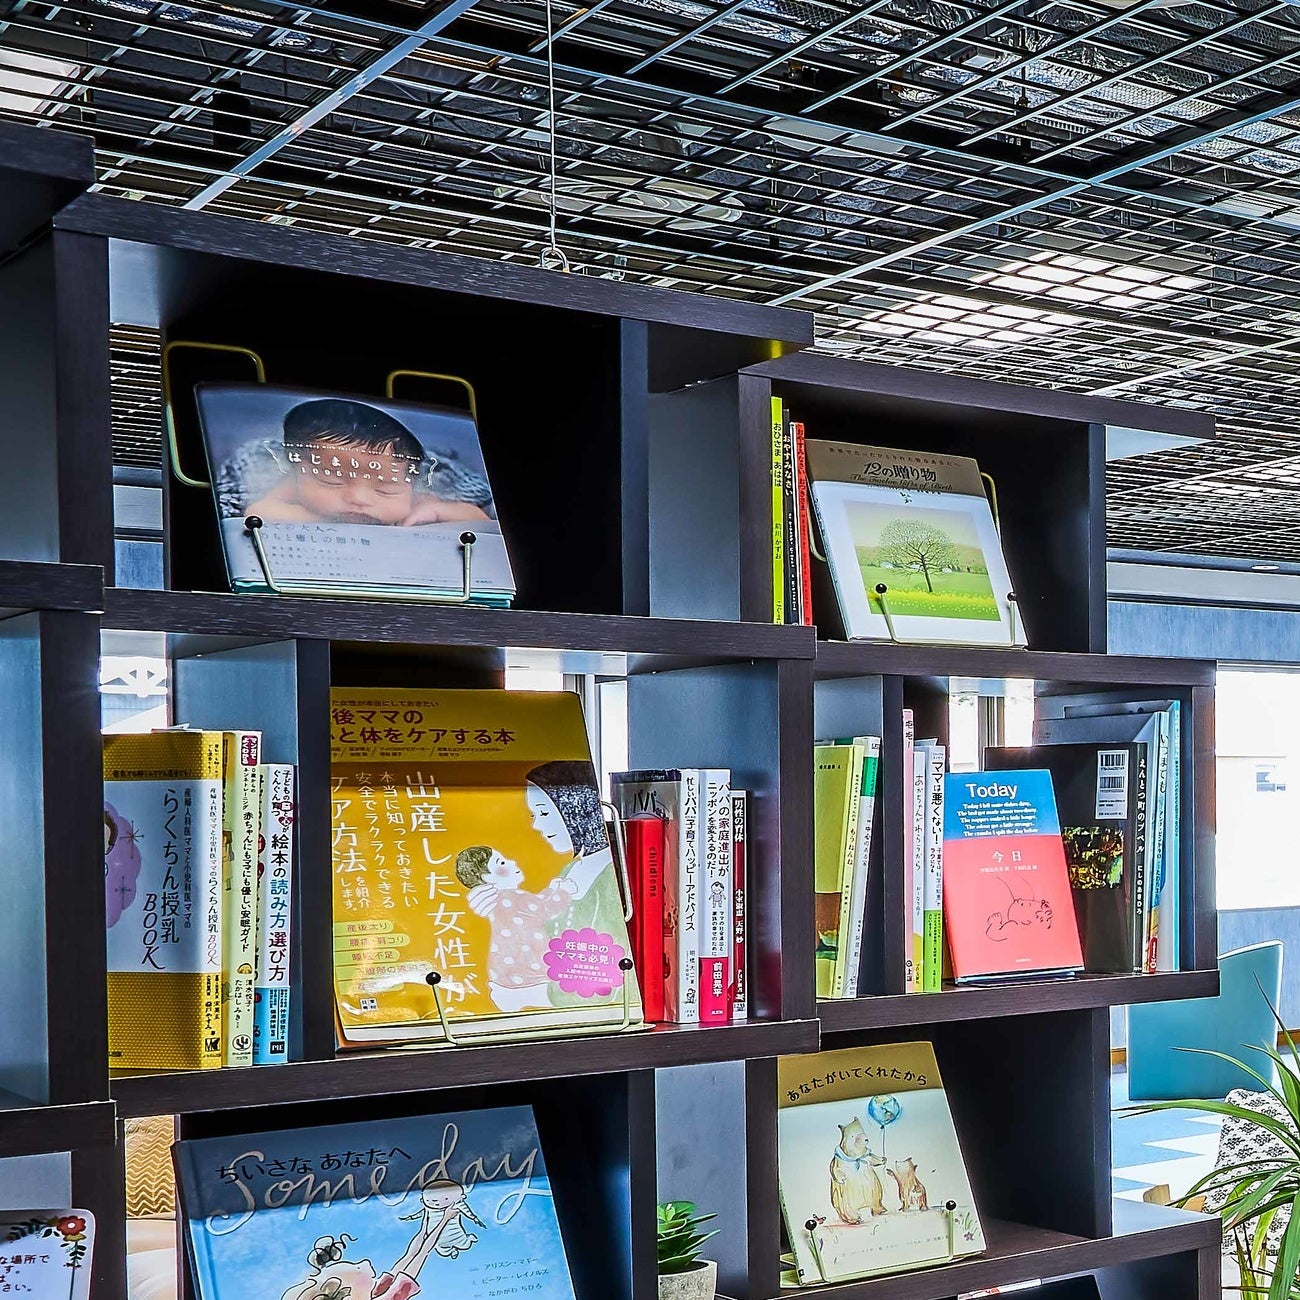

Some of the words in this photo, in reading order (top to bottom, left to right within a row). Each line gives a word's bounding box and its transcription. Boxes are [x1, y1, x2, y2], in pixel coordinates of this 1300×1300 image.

[773, 422, 782, 457] おひさま
[288, 451, 420, 475] はじまりのこえ
[773, 461, 782, 487] あはは
[783, 434, 793, 497] おやすみなさい
[863, 461, 937, 482] 12の贈り物
[930, 761, 943, 845] ママは悪くない!
[964, 782, 1018, 800] Today
[1136, 758, 1147, 854] えんとつ町のプペル
[355, 772, 395, 909] 安全でラクラクできる
[380, 771, 419, 908] 本当に知っておきたい
[717, 782, 730, 877] パパの家庭進出が
[734, 799, 744, 843] 男性の育休
[161, 788, 182, 944] らくちん授乳
[183, 787, 192, 929] 産婦人科医ママと小児科医ママの
[992, 850, 1021, 863] 今日
[239, 812, 254, 953] 赤ちゃんにもママにも優しい安眠ガイド
[341, 877, 358, 912] します。
[356, 875, 371, 909] を紹介
[403, 771, 481, 1003] 出産した女性が
[141, 892, 166, 970] BOOK
[565, 941, 609, 954] 妊娠中の
[712, 961, 722, 997] 前田晃平
[786, 1064, 928, 1103] あなたがいてくれたから
[215, 1155, 313, 1184] ちいさな
[319, 1146, 412, 1171] あなたへ
